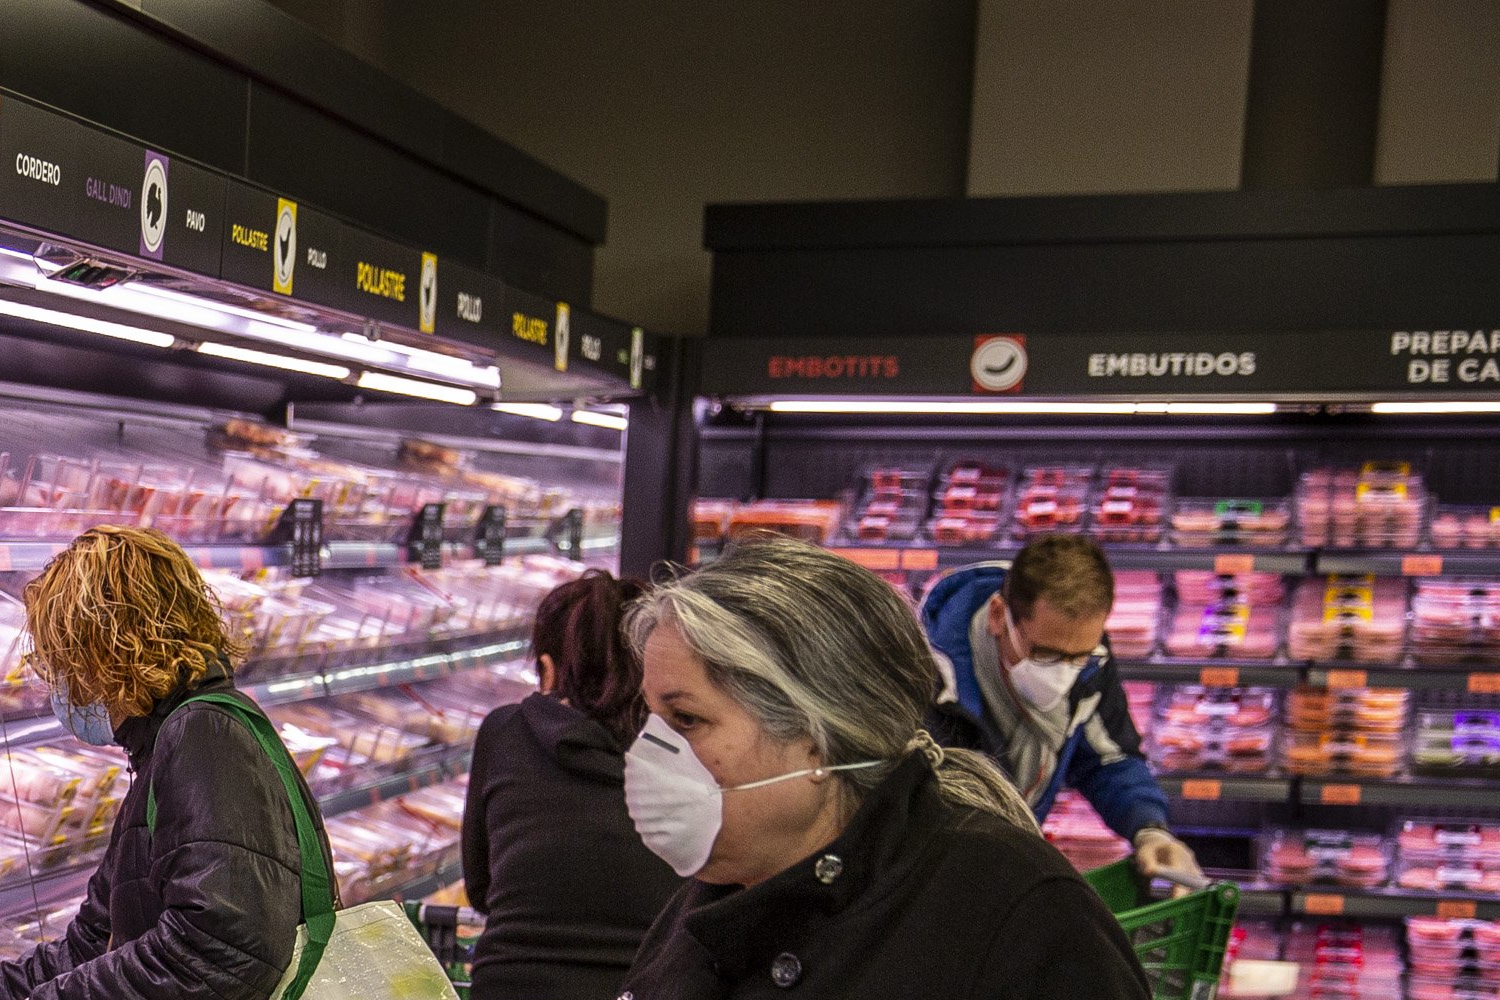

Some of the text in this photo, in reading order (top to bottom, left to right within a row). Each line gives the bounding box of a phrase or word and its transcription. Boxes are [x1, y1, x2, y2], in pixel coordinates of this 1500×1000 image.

[16, 153, 61, 186] CORDERO
[86, 177, 132, 209] GALL DINDI
[186, 209, 206, 232] PAVO
[232, 224, 268, 252] POLLASTRE
[307, 247, 328, 270] POLLO
[357, 261, 406, 302] POLLASTRE
[457, 291, 483, 323] POLLO
[767, 355, 899, 379] EMBOTITS
[1087, 352, 1257, 377] EMBUTIDOS
[1408, 358, 1500, 383] DE CA
